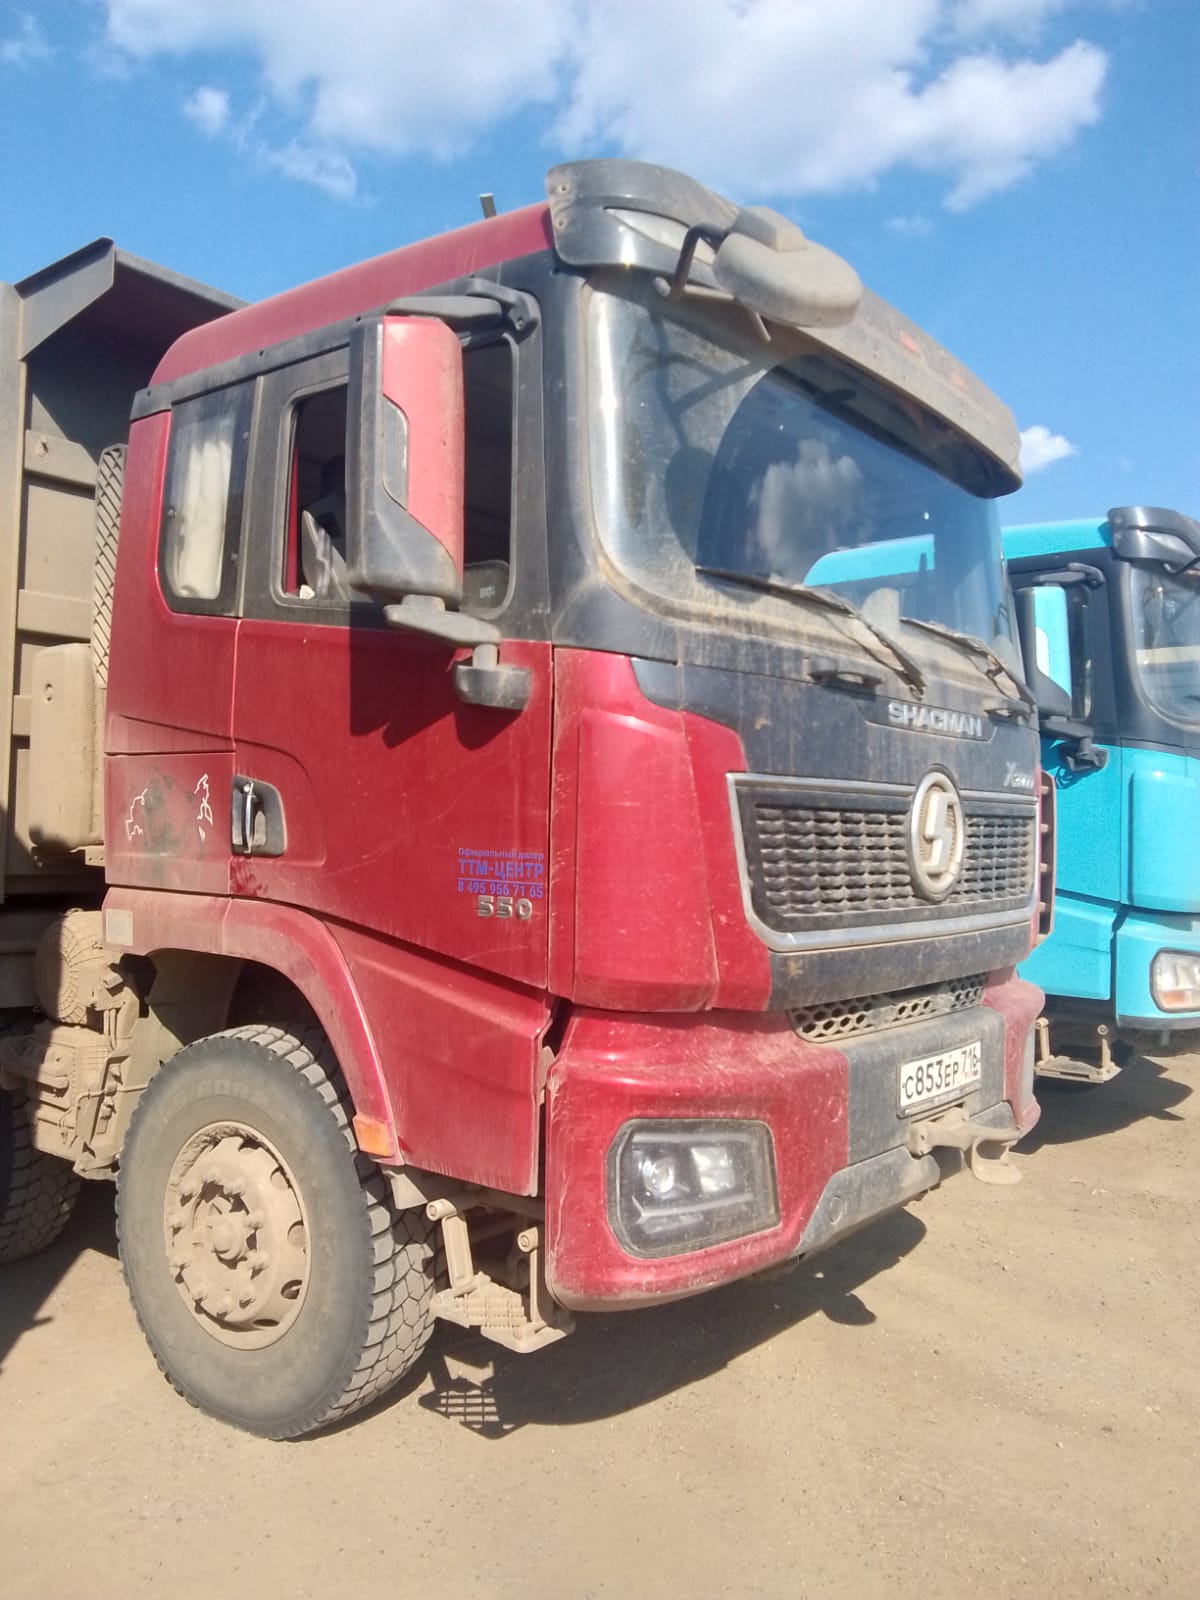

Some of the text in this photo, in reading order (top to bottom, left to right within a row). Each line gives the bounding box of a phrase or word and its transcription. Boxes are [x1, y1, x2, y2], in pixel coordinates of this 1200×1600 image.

[888, 702, 982, 737] SHACMAN
[458, 859, 544, 880] ТТМ-ЦЕНТР
[457, 880, 544, 898] 8 495 956 71 65
[477, 895, 533, 920] 550
